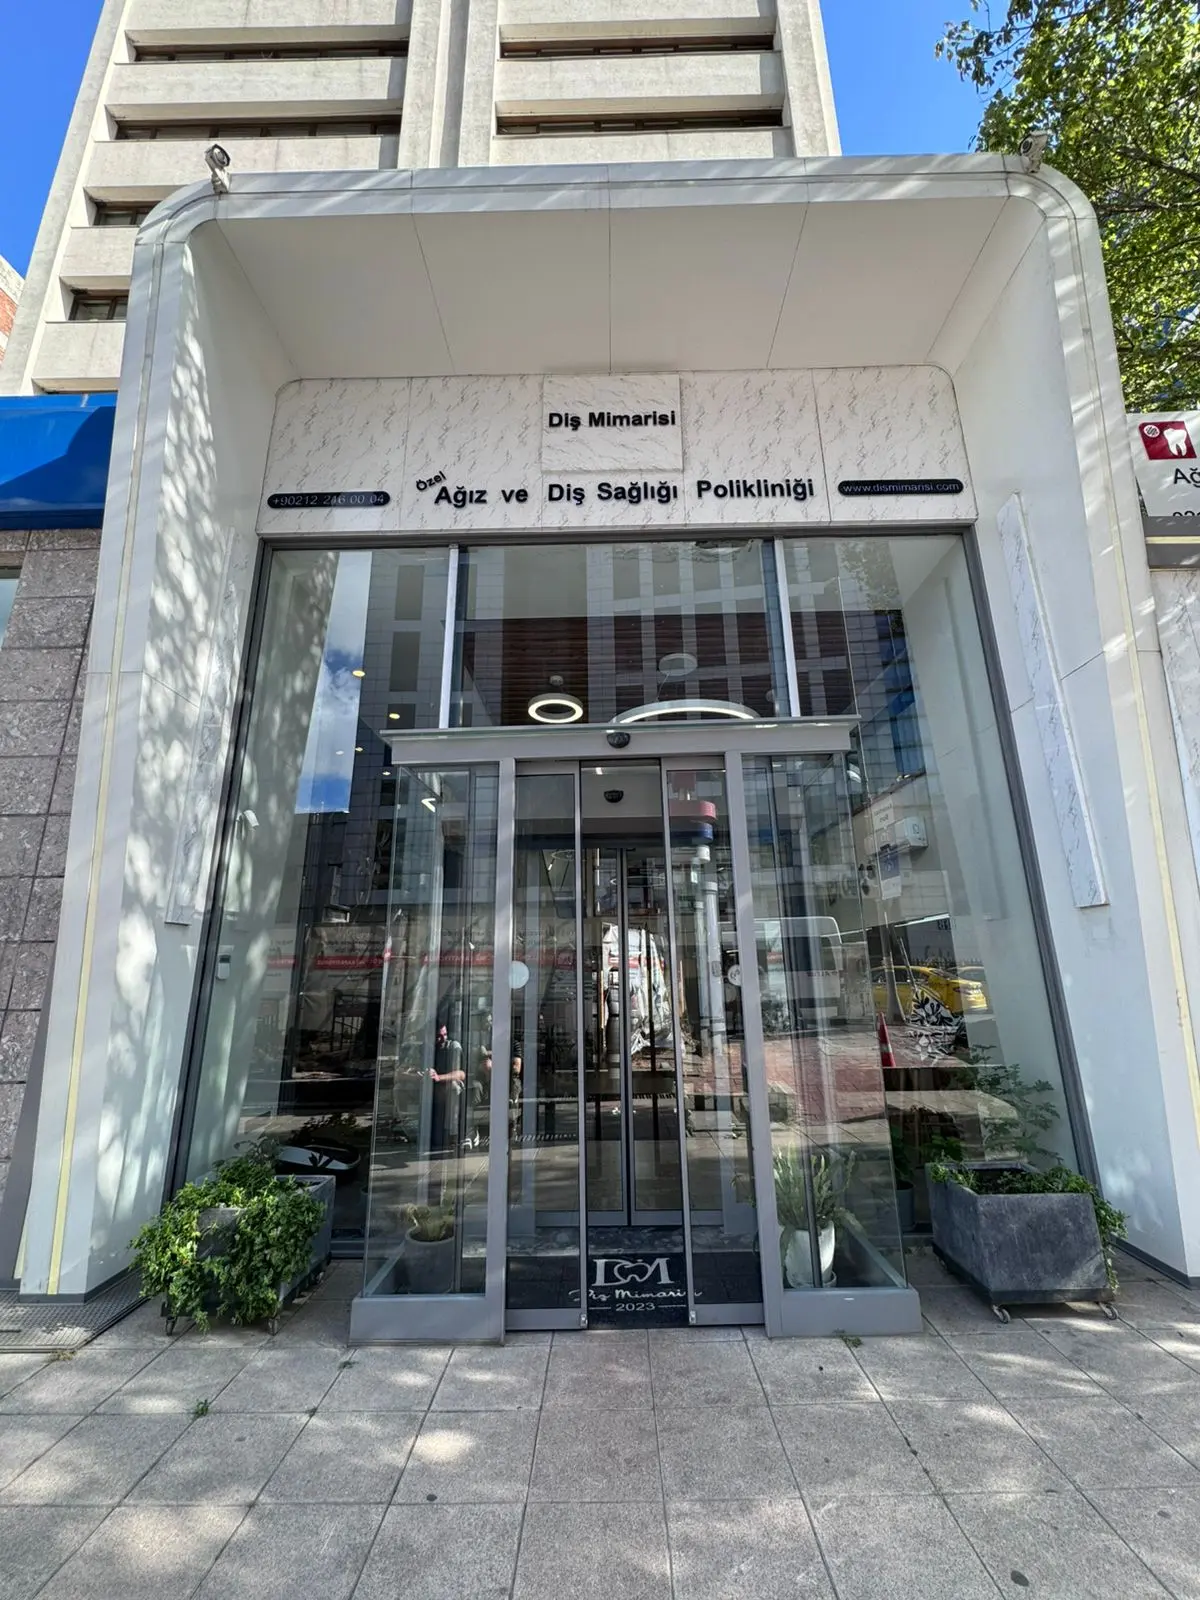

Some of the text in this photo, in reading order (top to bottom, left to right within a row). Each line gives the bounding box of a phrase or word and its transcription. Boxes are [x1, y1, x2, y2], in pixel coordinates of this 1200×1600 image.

[549, 410, 676, 430] Diş Mimarisi
[416, 470, 447, 491] Özel
[842, 482, 960, 493] www.dismimarisi.com
[272, 494, 318, 506] +90212
[434, 478, 815, 508] Ağız ve Diş Sağlığı Polikliniği
[615, 1303, 656, 1312] 2023
